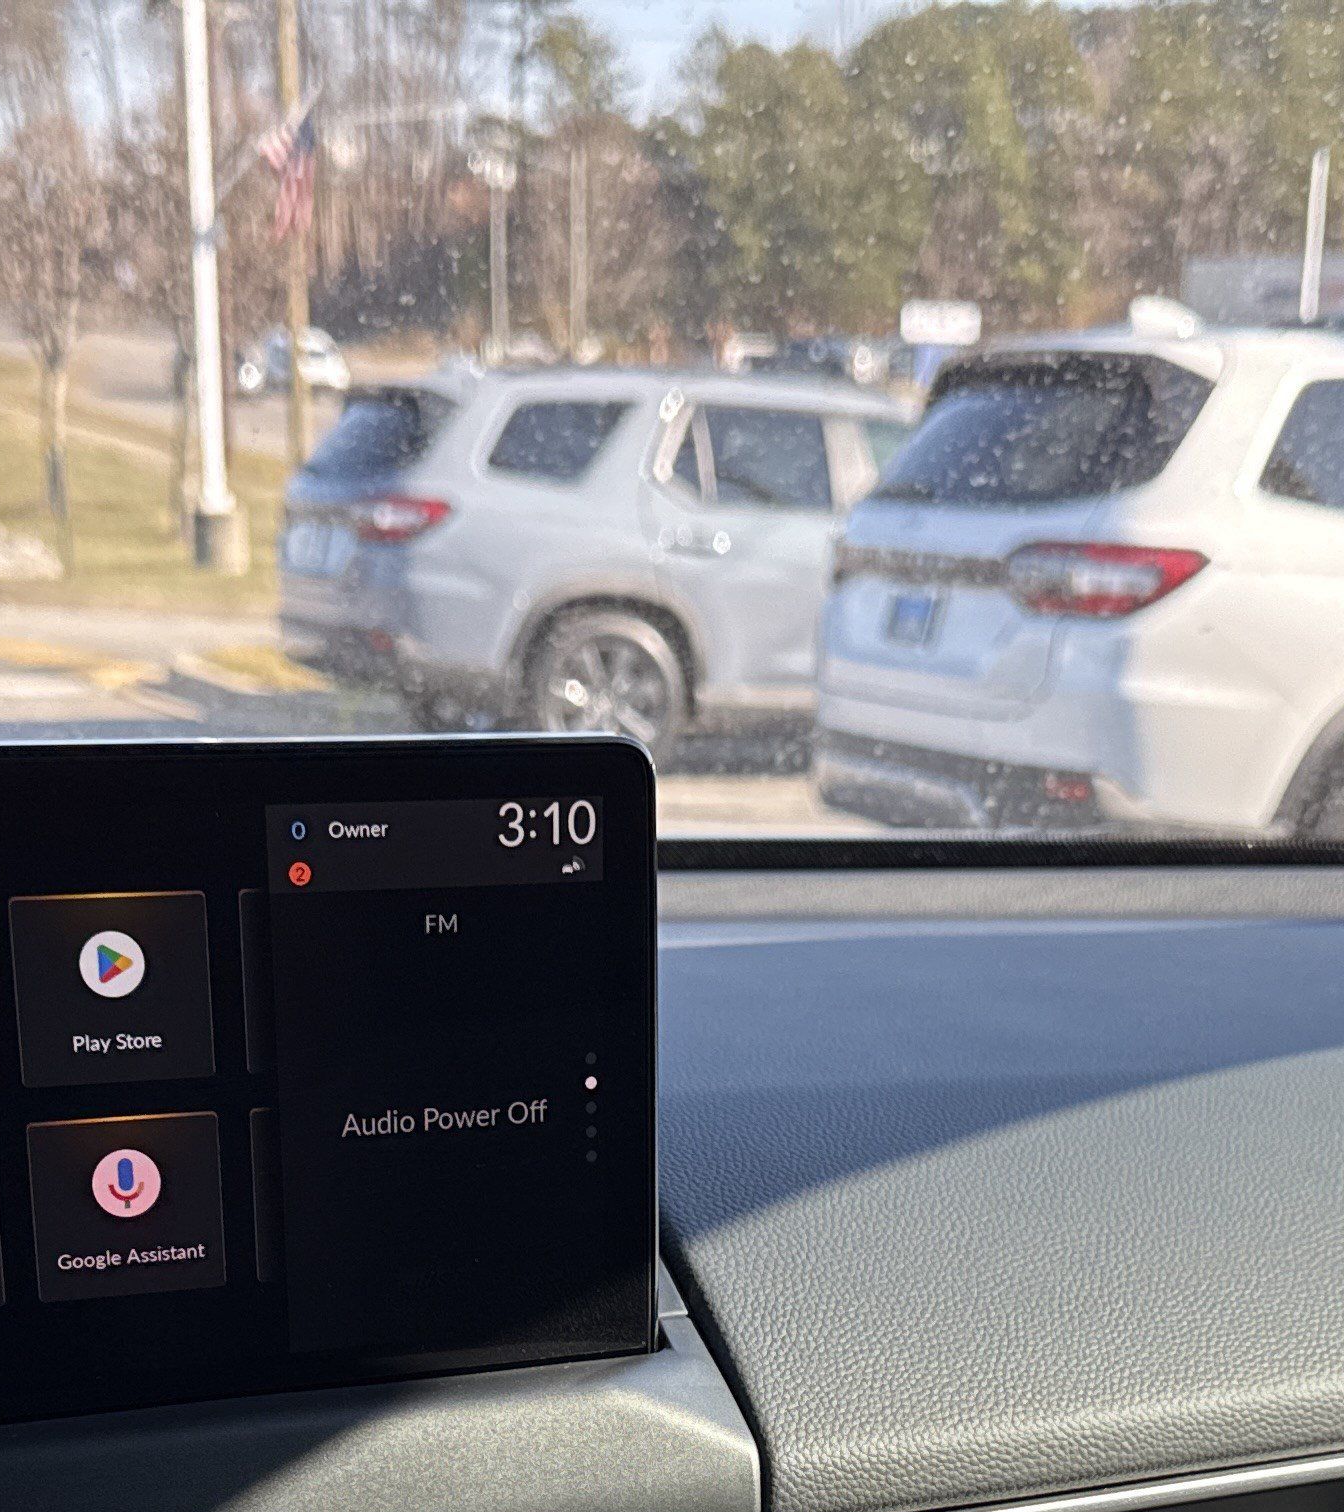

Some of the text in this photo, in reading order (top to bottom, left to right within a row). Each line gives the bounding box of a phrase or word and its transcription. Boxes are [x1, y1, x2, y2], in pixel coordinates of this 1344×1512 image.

[329, 822, 388, 838] Owner
[499, 800, 595, 847] 3:10
[426, 914, 457, 933] FM
[73, 1034, 162, 1053] Play Store
[342, 1099, 547, 1137] Audio Power Off
[58, 1244, 205, 1269] Google Assistant
